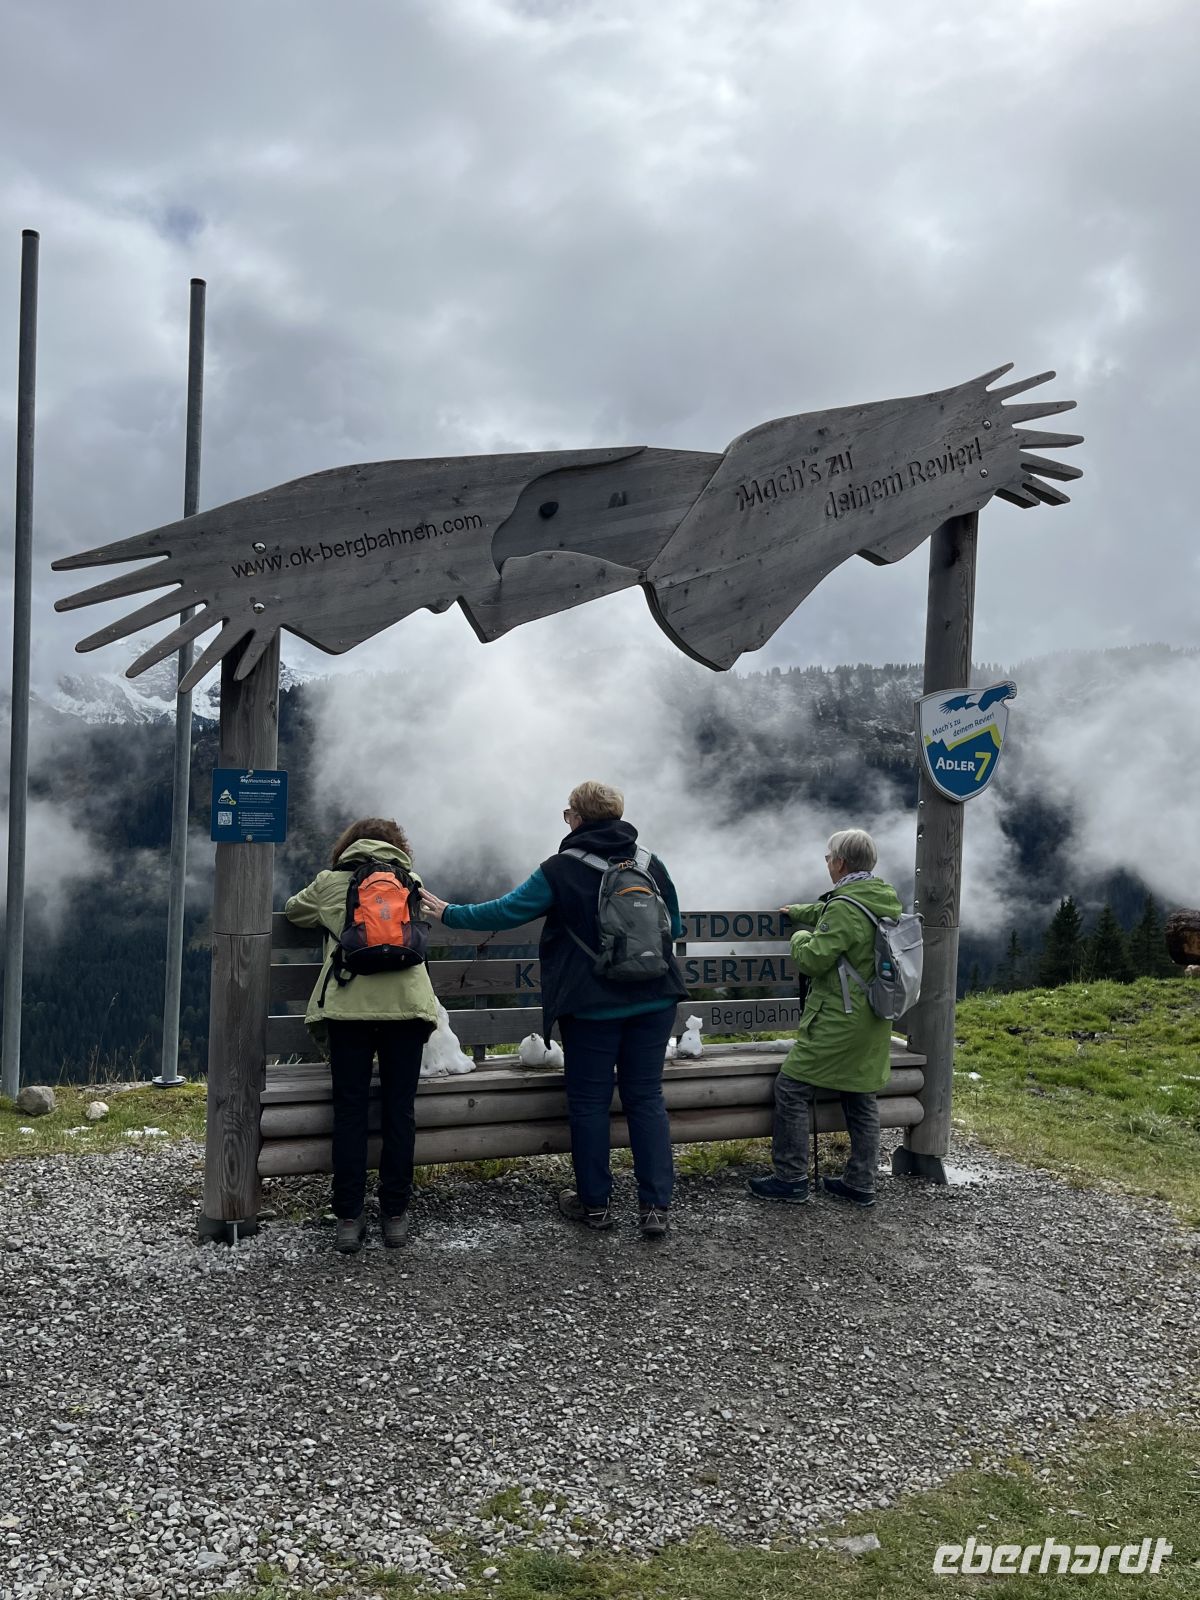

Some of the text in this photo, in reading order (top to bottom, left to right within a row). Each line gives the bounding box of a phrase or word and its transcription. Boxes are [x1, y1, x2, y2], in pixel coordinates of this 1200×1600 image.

[735, 450, 852, 511] Mach's zu
[824, 436, 983, 518] deinem Revier!
[231, 512, 483, 579] www.ok-bergbahnen.com
[932, 718, 961, 737] Mach's zu
[953, 712, 994, 737] deinem Revier!
[935, 751, 992, 782] ADLER 7
